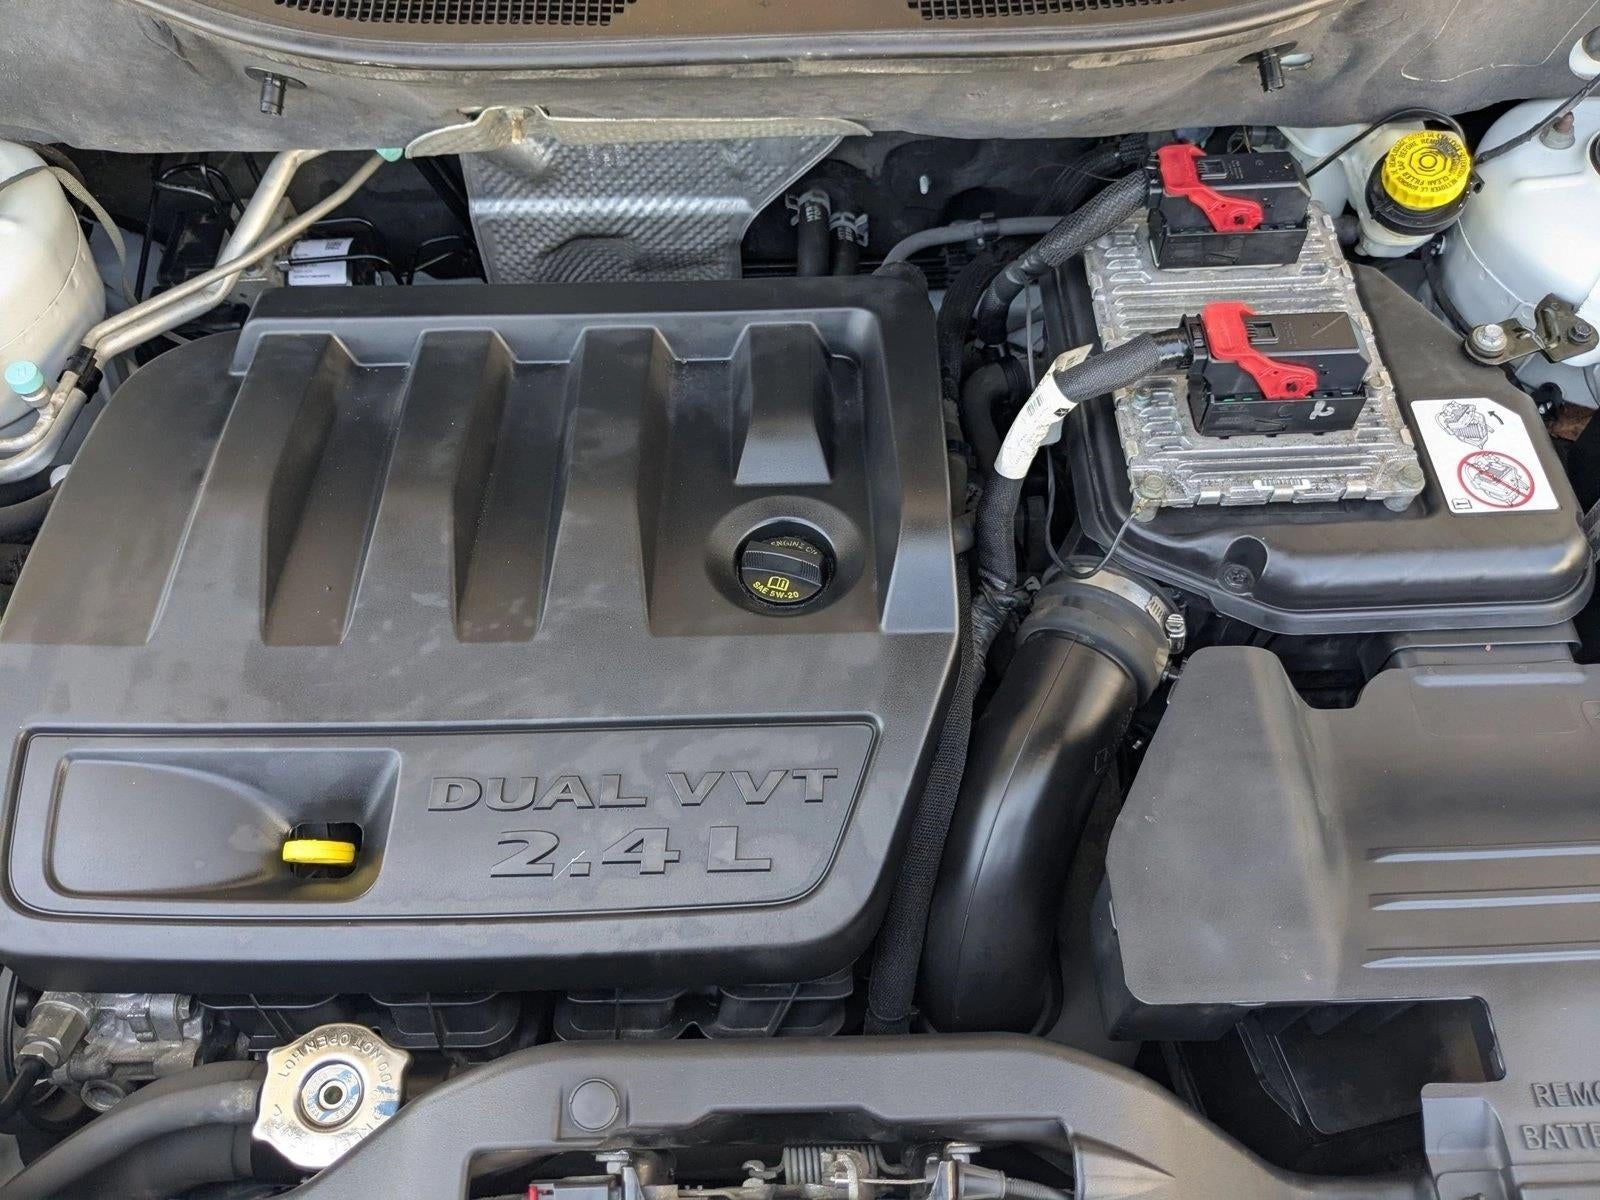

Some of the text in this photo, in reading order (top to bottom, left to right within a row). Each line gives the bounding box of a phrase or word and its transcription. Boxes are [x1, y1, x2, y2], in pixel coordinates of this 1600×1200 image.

[752, 581, 799, 599] SAE 5W-20
[428, 768, 838, 812] DUAL VVT
[490, 825, 772, 878] 2.4 L
[277, 1032, 393, 1083] DO NOT OPEN HOT
